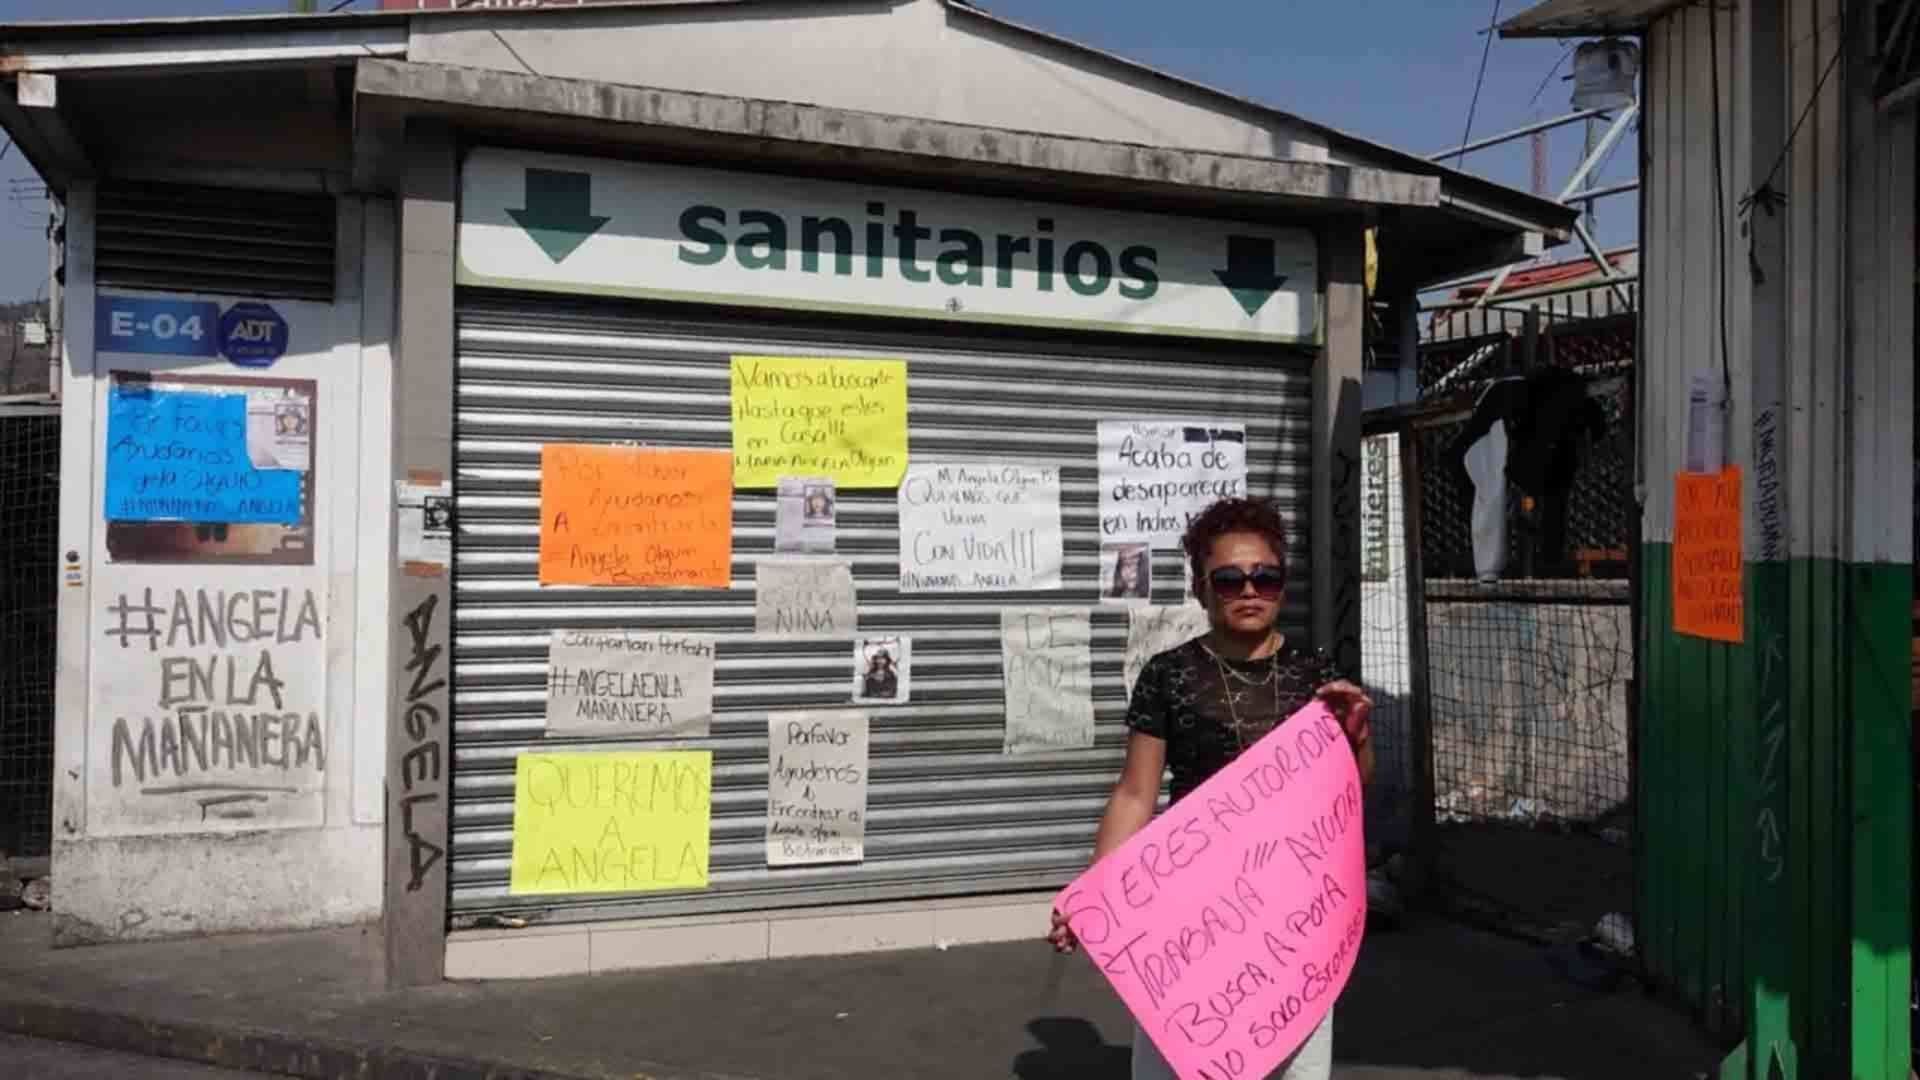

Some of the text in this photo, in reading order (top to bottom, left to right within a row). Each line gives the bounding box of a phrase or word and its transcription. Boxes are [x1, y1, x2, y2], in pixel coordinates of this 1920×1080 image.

[677, 200, 1160, 299] sanitarios
[110, 311, 205, 341] E-04
[228, 320, 279, 342] ADT
[1118, 434, 1231, 471] Acaba de
[1103, 513, 1128, 535] en
[104, 587, 322, 651] #ANGELA
[158, 649, 285, 710] EN LA
[110, 705, 327, 788] MAÑANERA
[401, 593, 446, 893] ANGELA
[597, 814, 626, 855] A
[535, 840, 706, 890] ANGELA
